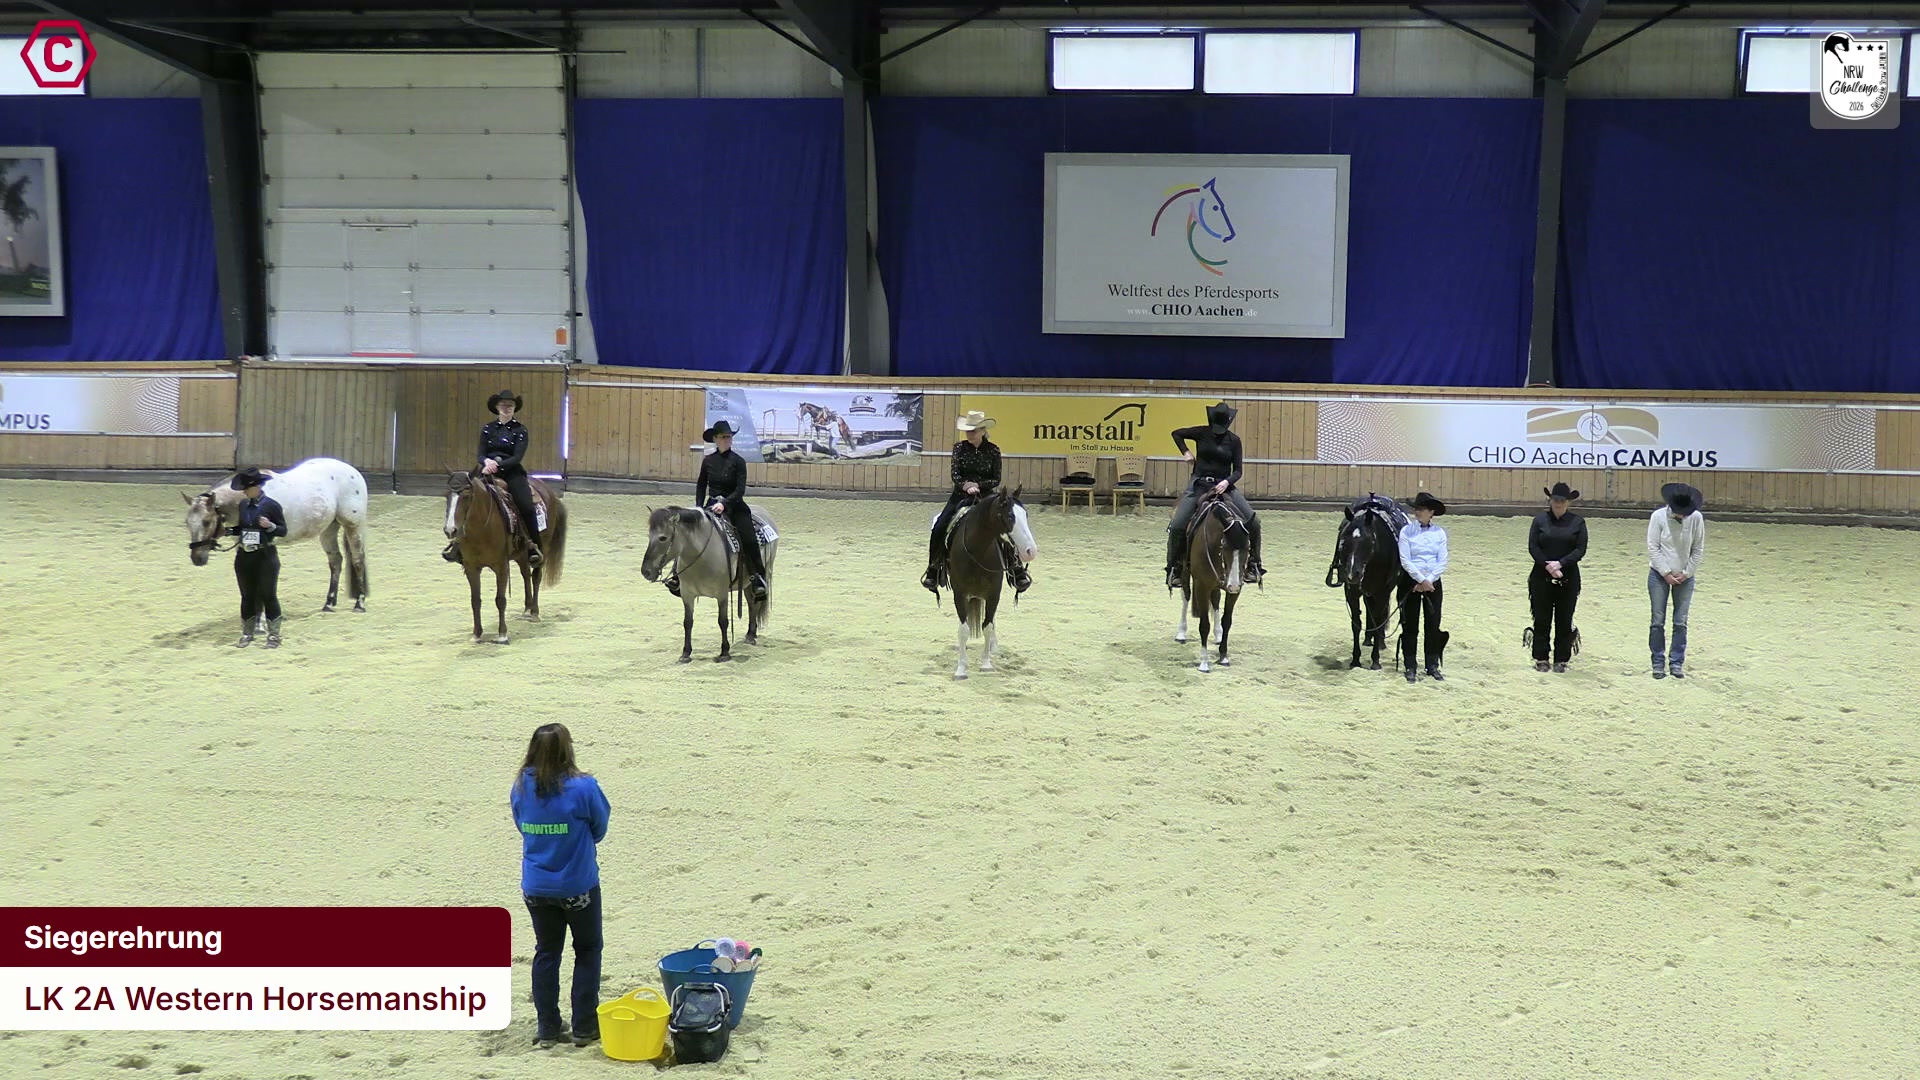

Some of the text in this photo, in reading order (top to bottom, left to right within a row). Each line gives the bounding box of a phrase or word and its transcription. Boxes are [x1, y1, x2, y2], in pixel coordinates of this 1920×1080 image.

[1107, 284, 1279, 302] Weltfest des Pferdesports
[1033, 420, 1134, 441] marstall
[1081, 443, 1099, 452] Stall
[1110, 444, 1134, 452] Hause
[1467, 446, 1718, 468] CHIO Aachen CAMPUS
